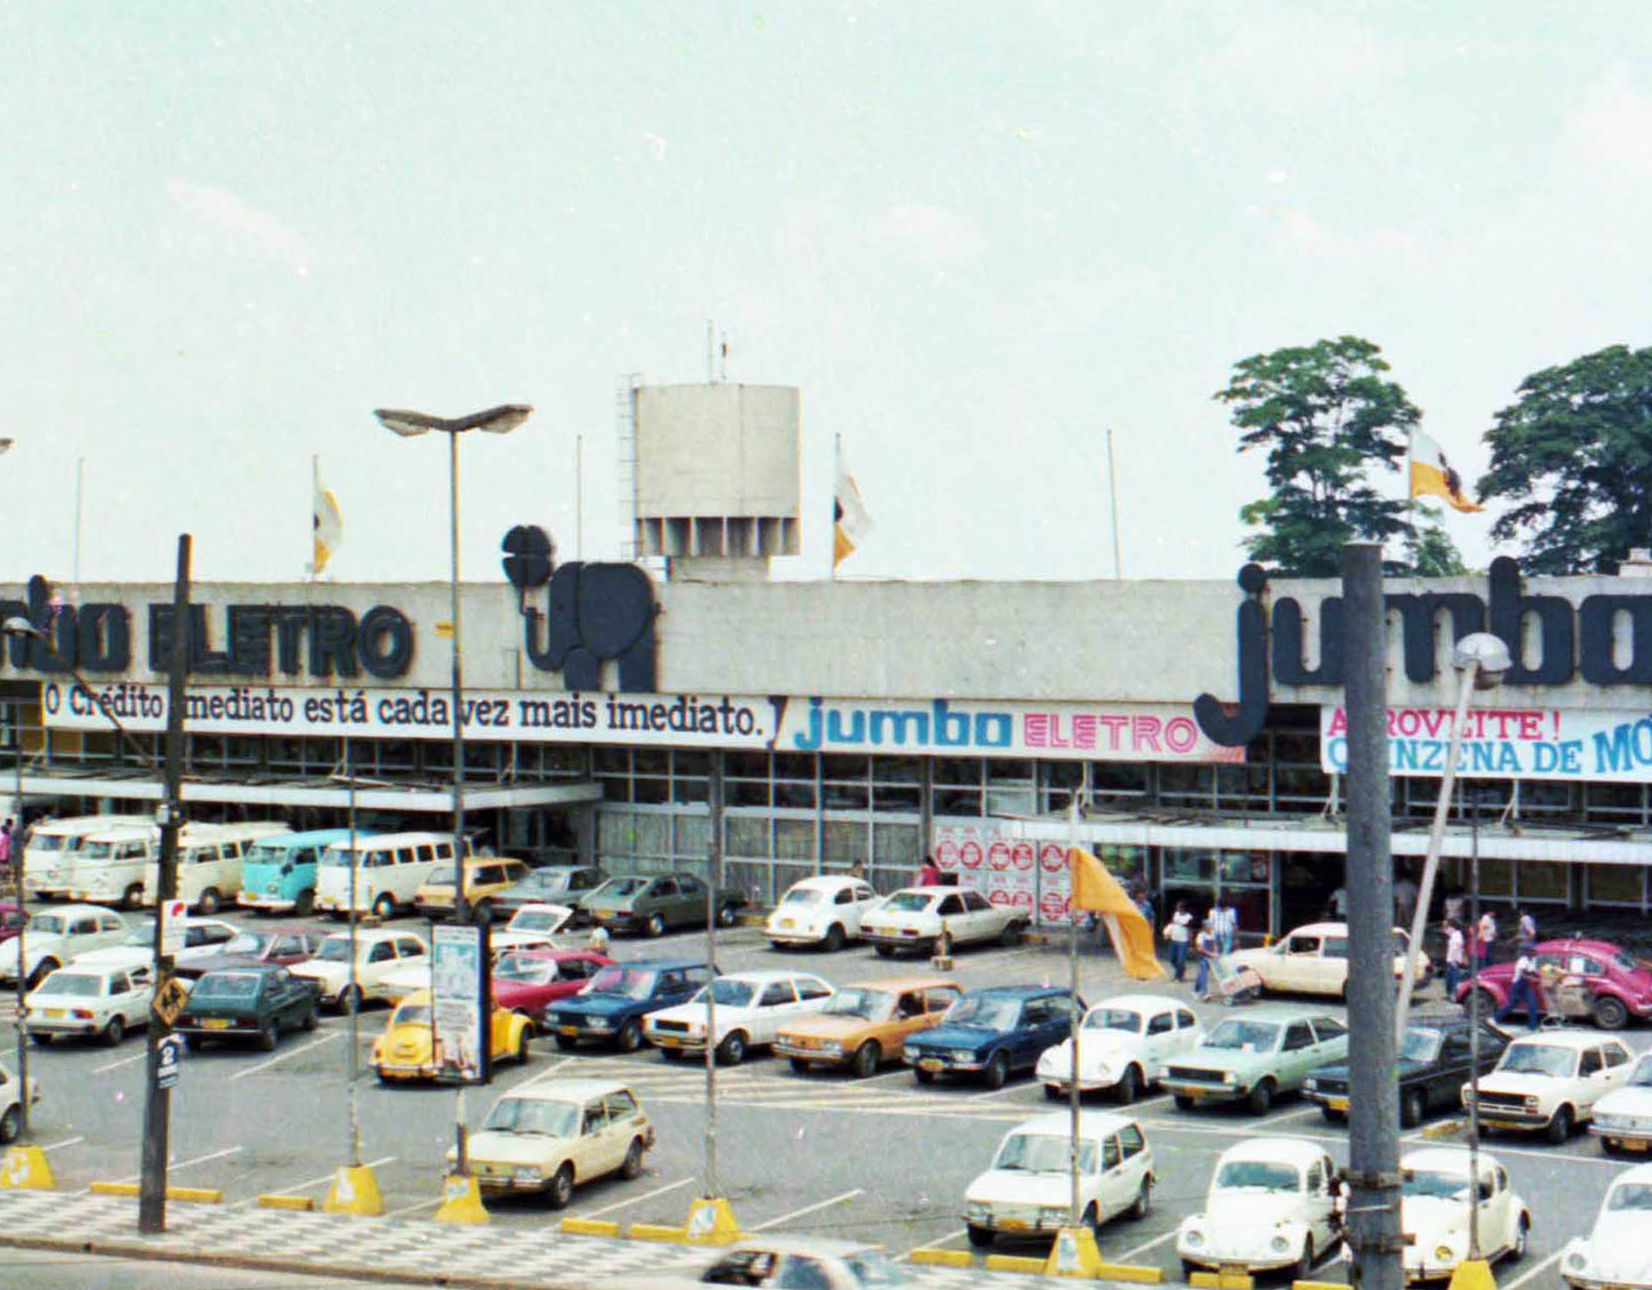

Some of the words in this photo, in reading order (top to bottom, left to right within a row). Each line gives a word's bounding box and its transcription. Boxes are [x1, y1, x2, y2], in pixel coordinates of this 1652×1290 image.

[148, 603, 415, 679] ELETRO
[45, 683, 61, 716] O
[69, 683, 163, 719] Crédito
[175, 688, 295, 723] mediato
[304, 690, 368, 725] está
[378, 690, 450, 726] cada
[457, 698, 510, 727] vez
[520, 692, 597, 729] mais
[607, 693, 764, 736] imediato.
[794, 696, 1013, 751] jumbo
[1024, 712, 1198, 754] ELETRO
[1534, 740, 1583, 774] DE
